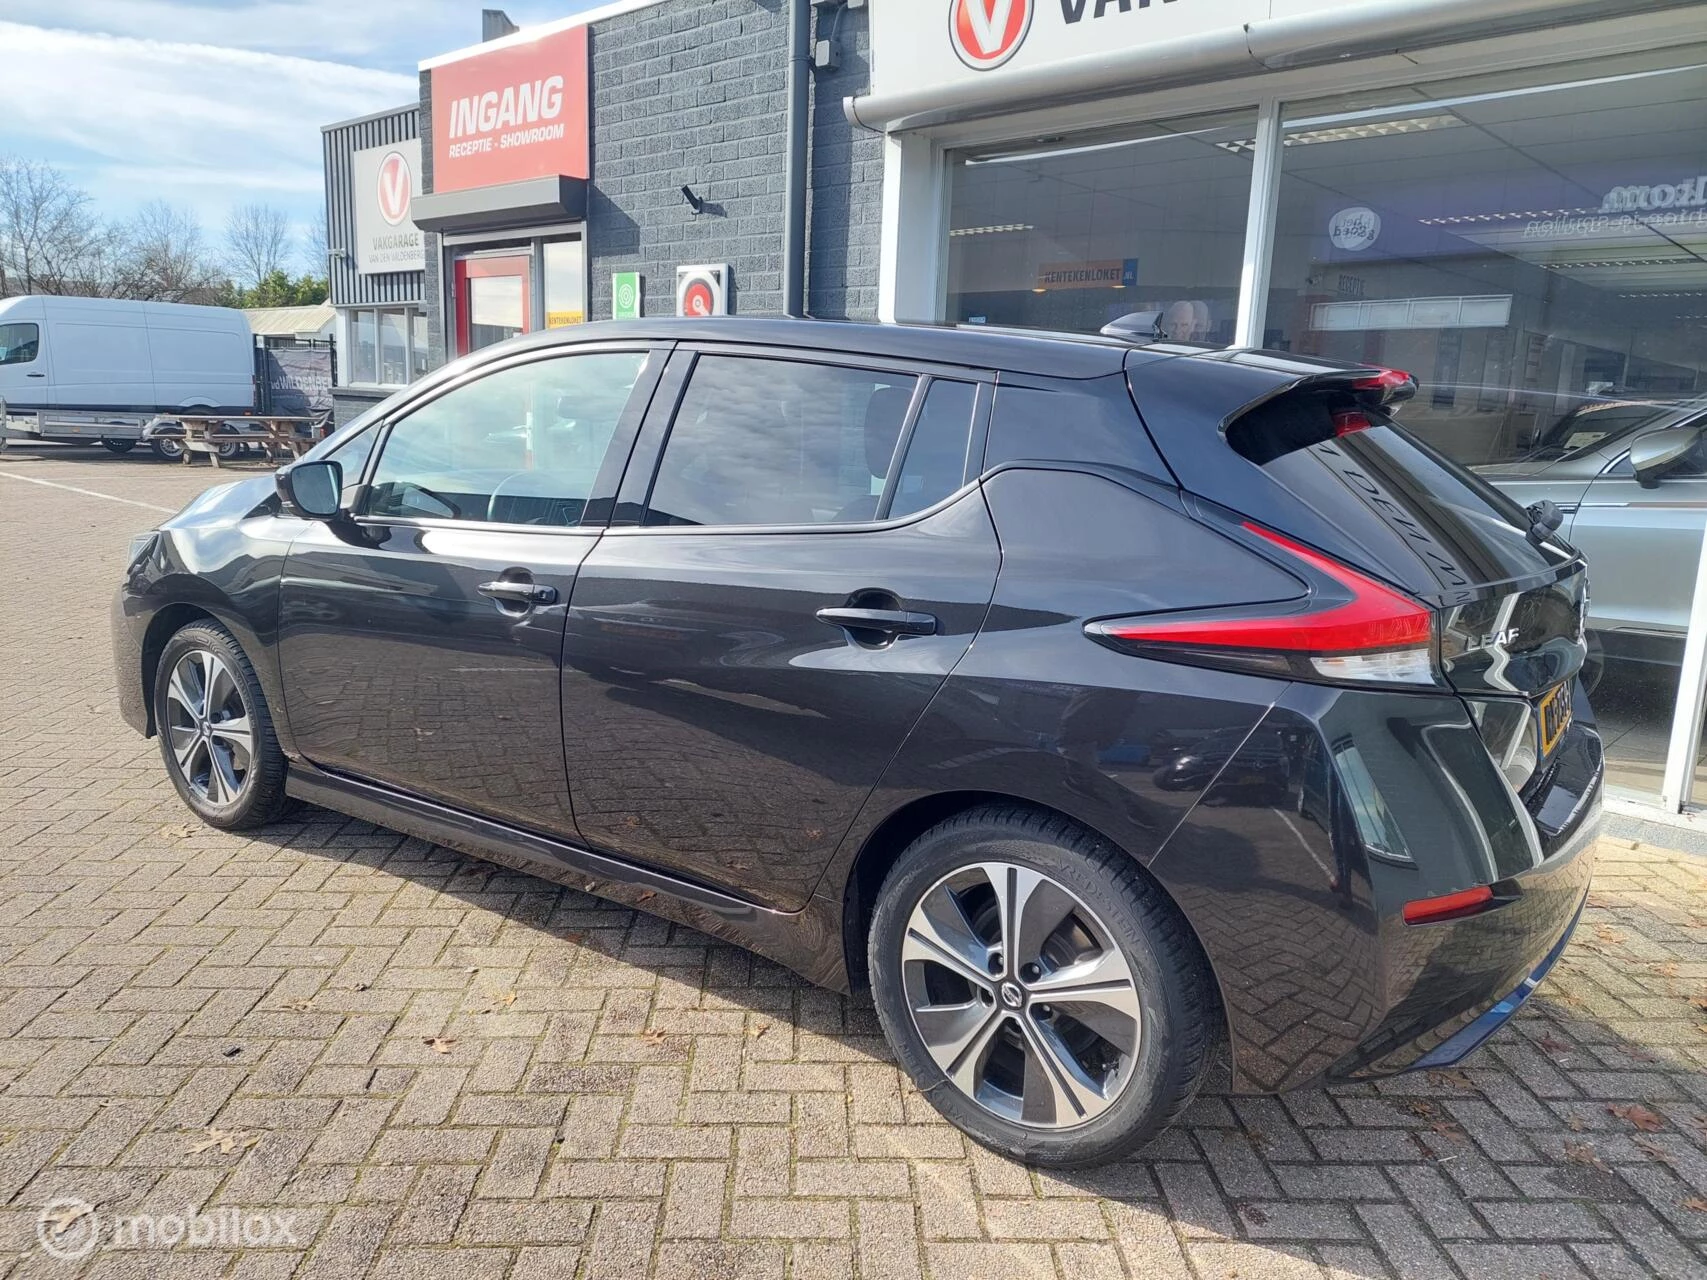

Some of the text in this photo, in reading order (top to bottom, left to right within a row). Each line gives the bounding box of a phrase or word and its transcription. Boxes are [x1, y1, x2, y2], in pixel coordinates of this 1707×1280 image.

[449, 75, 564, 139] INGANG
[449, 123, 565, 158] RECEPTIE SHOWROOM
[372, 232, 420, 251] VAKGARAGE
[1467, 627, 1520, 651] LEAF
